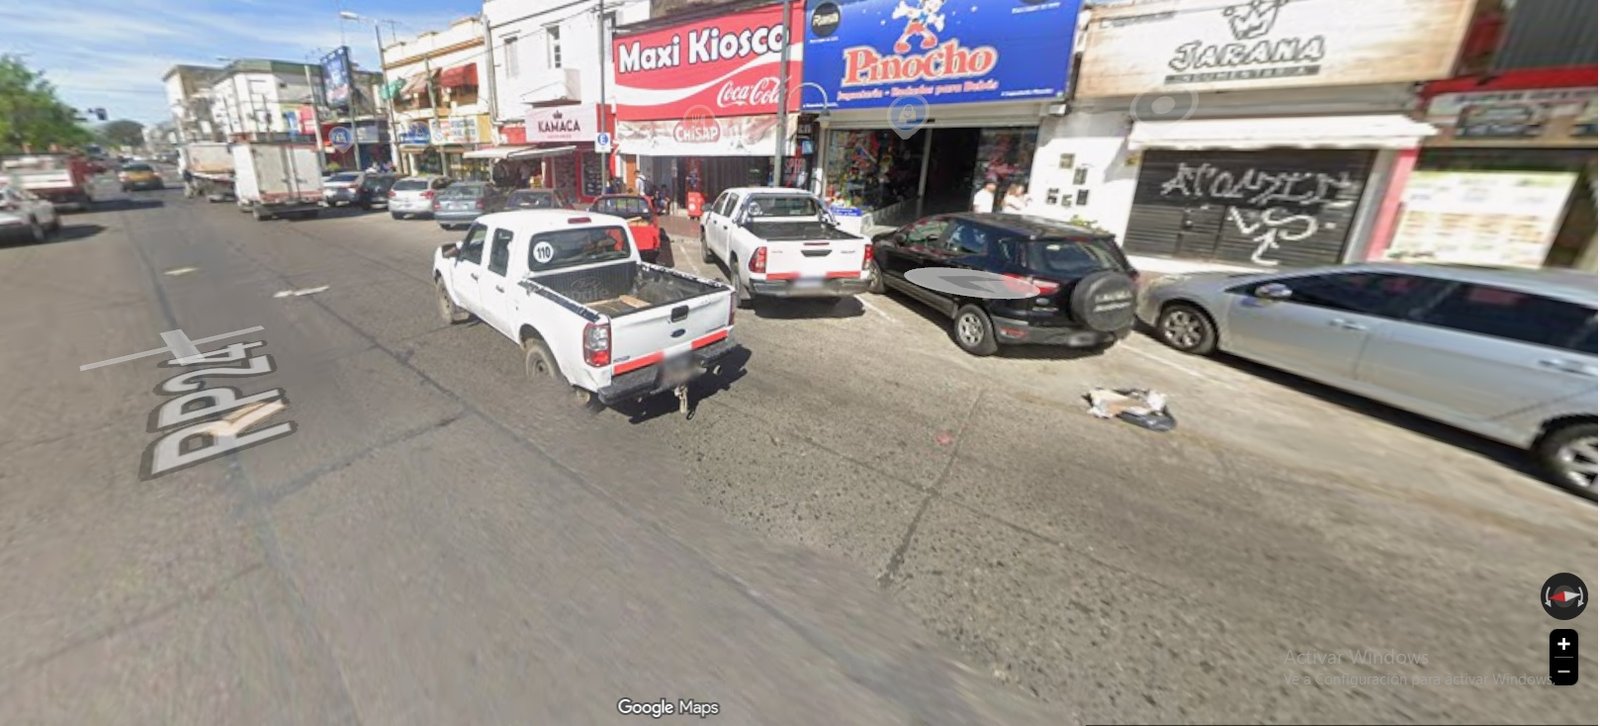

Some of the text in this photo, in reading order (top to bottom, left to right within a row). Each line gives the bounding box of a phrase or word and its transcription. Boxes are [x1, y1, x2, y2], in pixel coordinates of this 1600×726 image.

[618, 24, 790, 73] Maxi Kiosco
[842, 41, 997, 86] Pinocho
[1168, 36, 1324, 71] JARANA
[537, 120, 581, 132] KAMACA
[536, 246, 551, 259] 110
